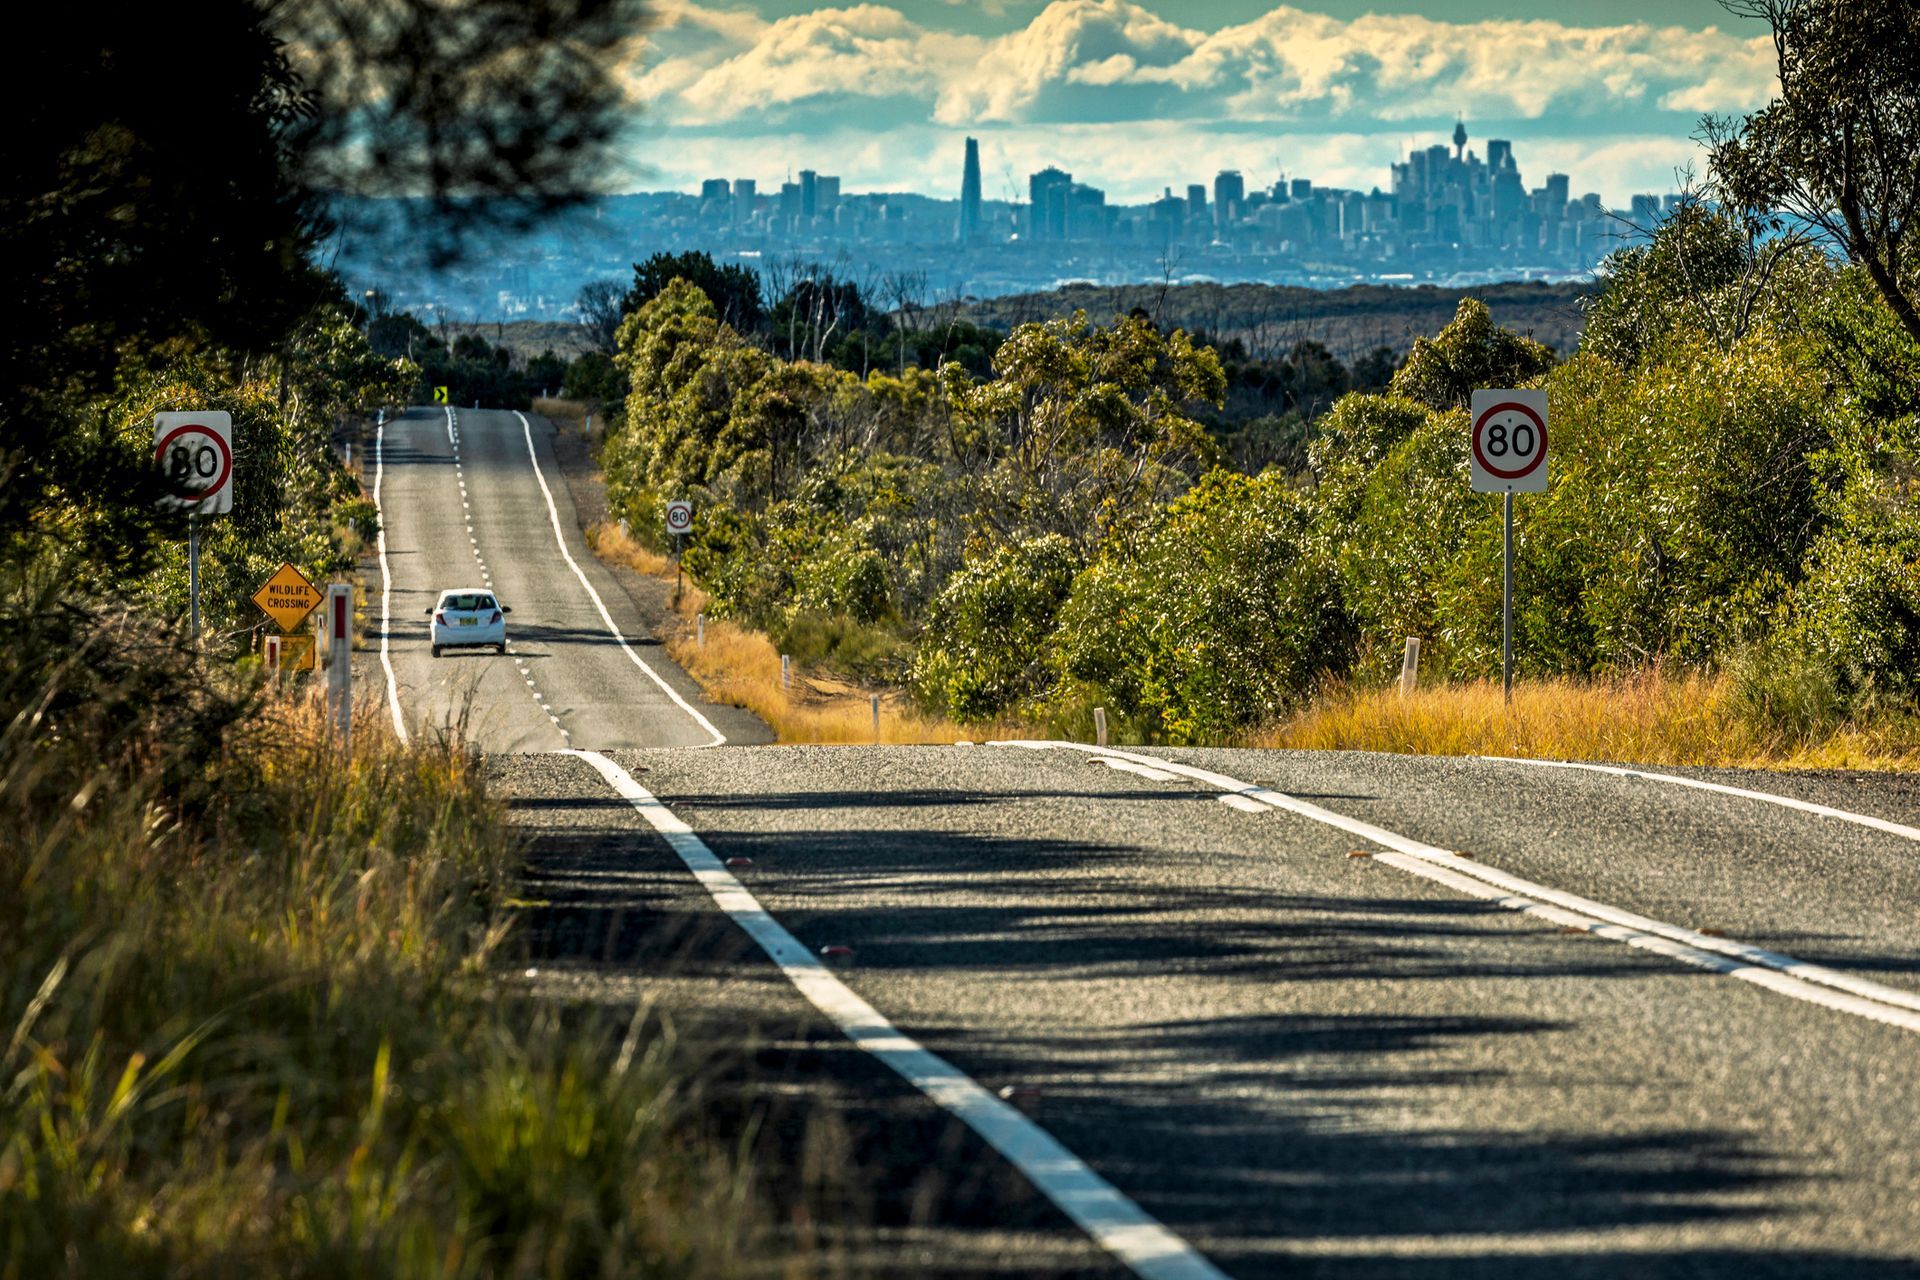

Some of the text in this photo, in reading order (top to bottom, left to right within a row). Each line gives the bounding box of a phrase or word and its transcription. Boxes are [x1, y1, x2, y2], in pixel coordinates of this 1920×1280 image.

[1487, 424, 1534, 457] 80
[171, 446, 217, 478] 80
[672, 512, 686, 521] 80
[269, 585, 310, 596] WILDLIFE
[267, 598, 310, 609] CROSSING
